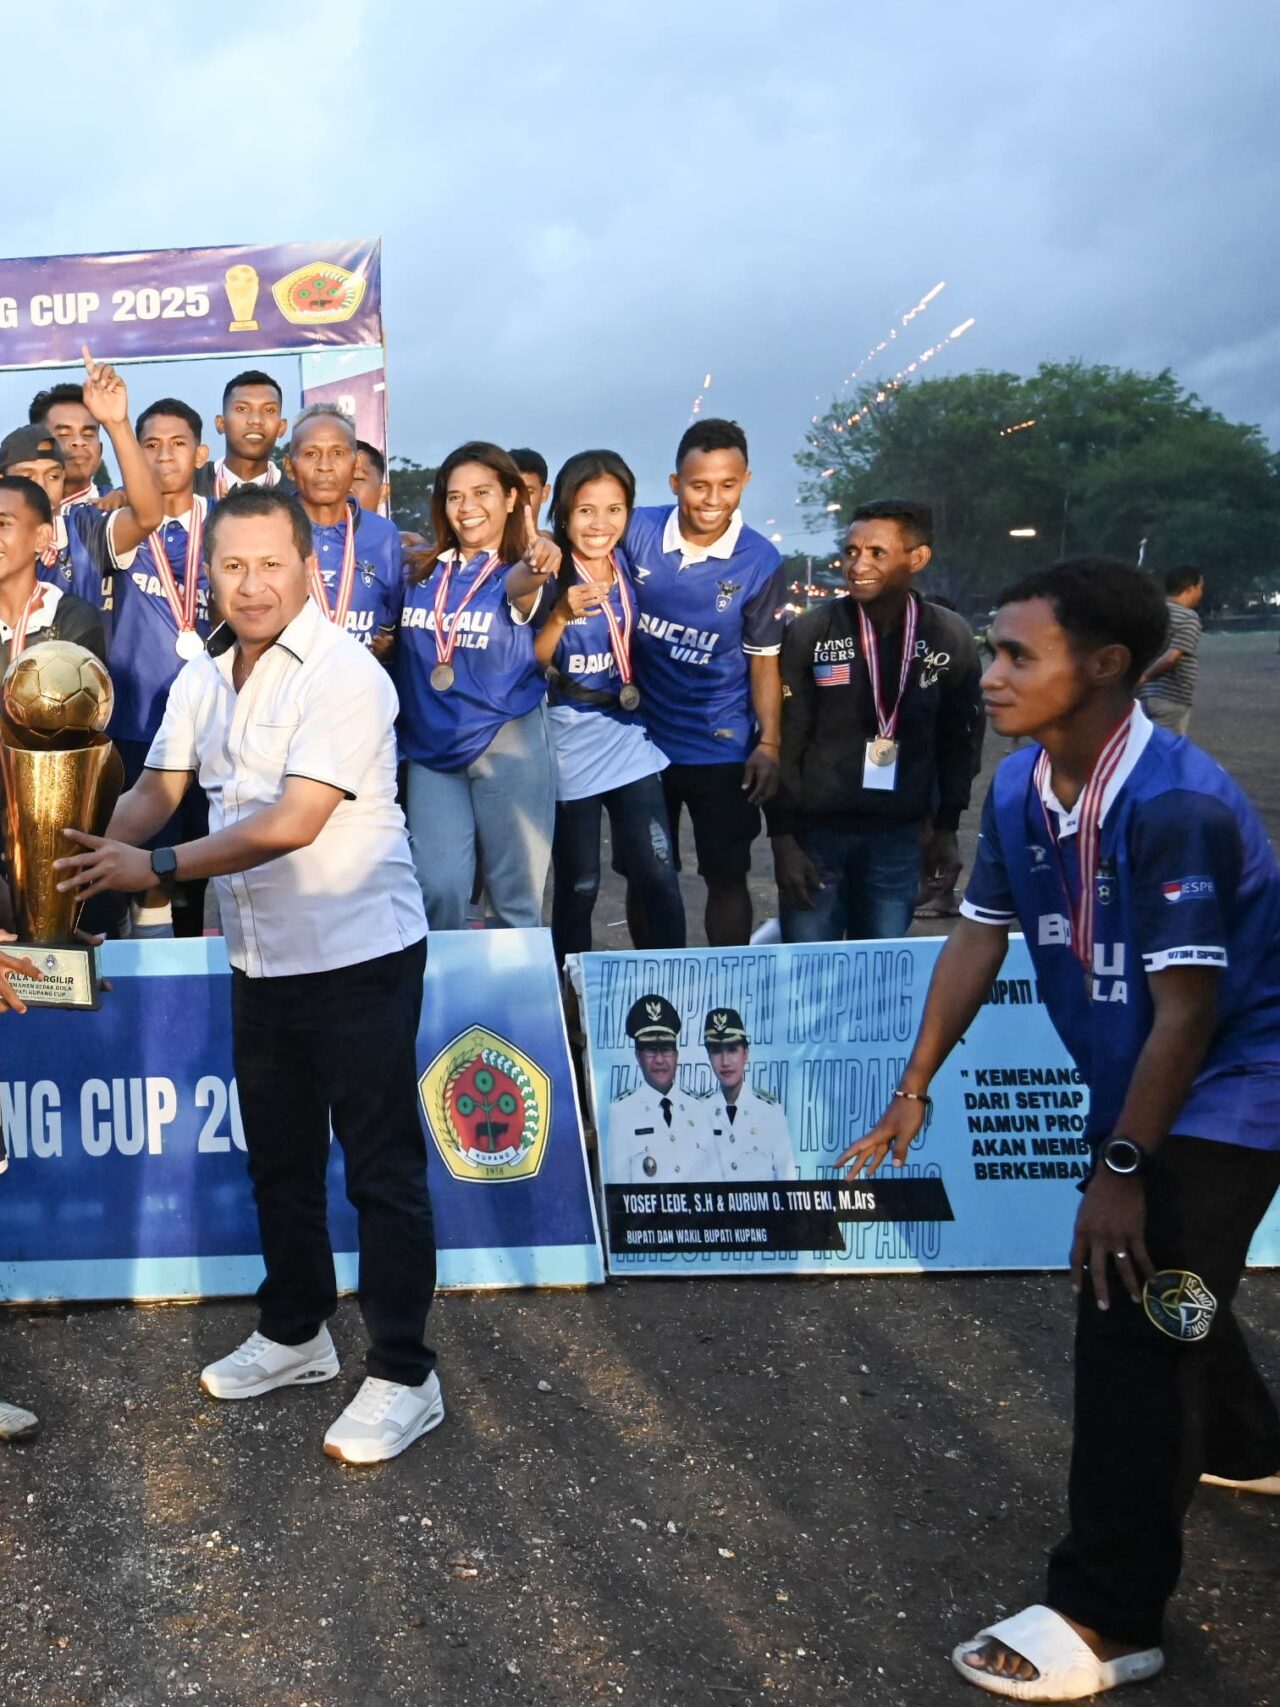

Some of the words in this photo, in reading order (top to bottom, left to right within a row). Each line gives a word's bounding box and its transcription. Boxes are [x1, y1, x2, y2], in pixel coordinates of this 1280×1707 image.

[30, 292, 100, 326] CUP
[112, 286, 210, 322] 2025
[670, 645, 712, 665] VILA
[813, 649, 855, 662] IGERS
[787, 950, 914, 1044] KUPANG
[985, 979, 1032, 1004] UPATI
[964, 1092, 1010, 1110] DARI
[1015, 1091, 1083, 1109] SETIAP
[80, 1076, 178, 1157] CUP
[967, 1115, 1040, 1133] NAMUN
[1044, 1114, 1087, 1132] PRO
[476, 1152, 511, 1161] KUPANG
[972, 1139, 1027, 1157] AKAN
[623, 1193, 658, 1214] YOSEF
[660, 1193, 692, 1215] LEDE,
[694, 1192, 714, 1213] S.H
[717, 1194, 725, 1212] &
[728, 1192, 770, 1212] AURUM
[787, 1190, 811, 1211] TITU
[814, 1190, 837, 1213] EKI,
[838, 1190, 876, 1210] M.Ars
[626, 1230, 656, 1245] BUPATI
[657, 1229, 674, 1244] DAN
[675, 1229, 702, 1244] WAKIL
[704, 1228, 733, 1243] BUPATI
[734, 1228, 768, 1243] KUPANG
[1185, 1277, 1214, 1308] ISLAND
[1185, 1311, 1211, 1337] STONE
